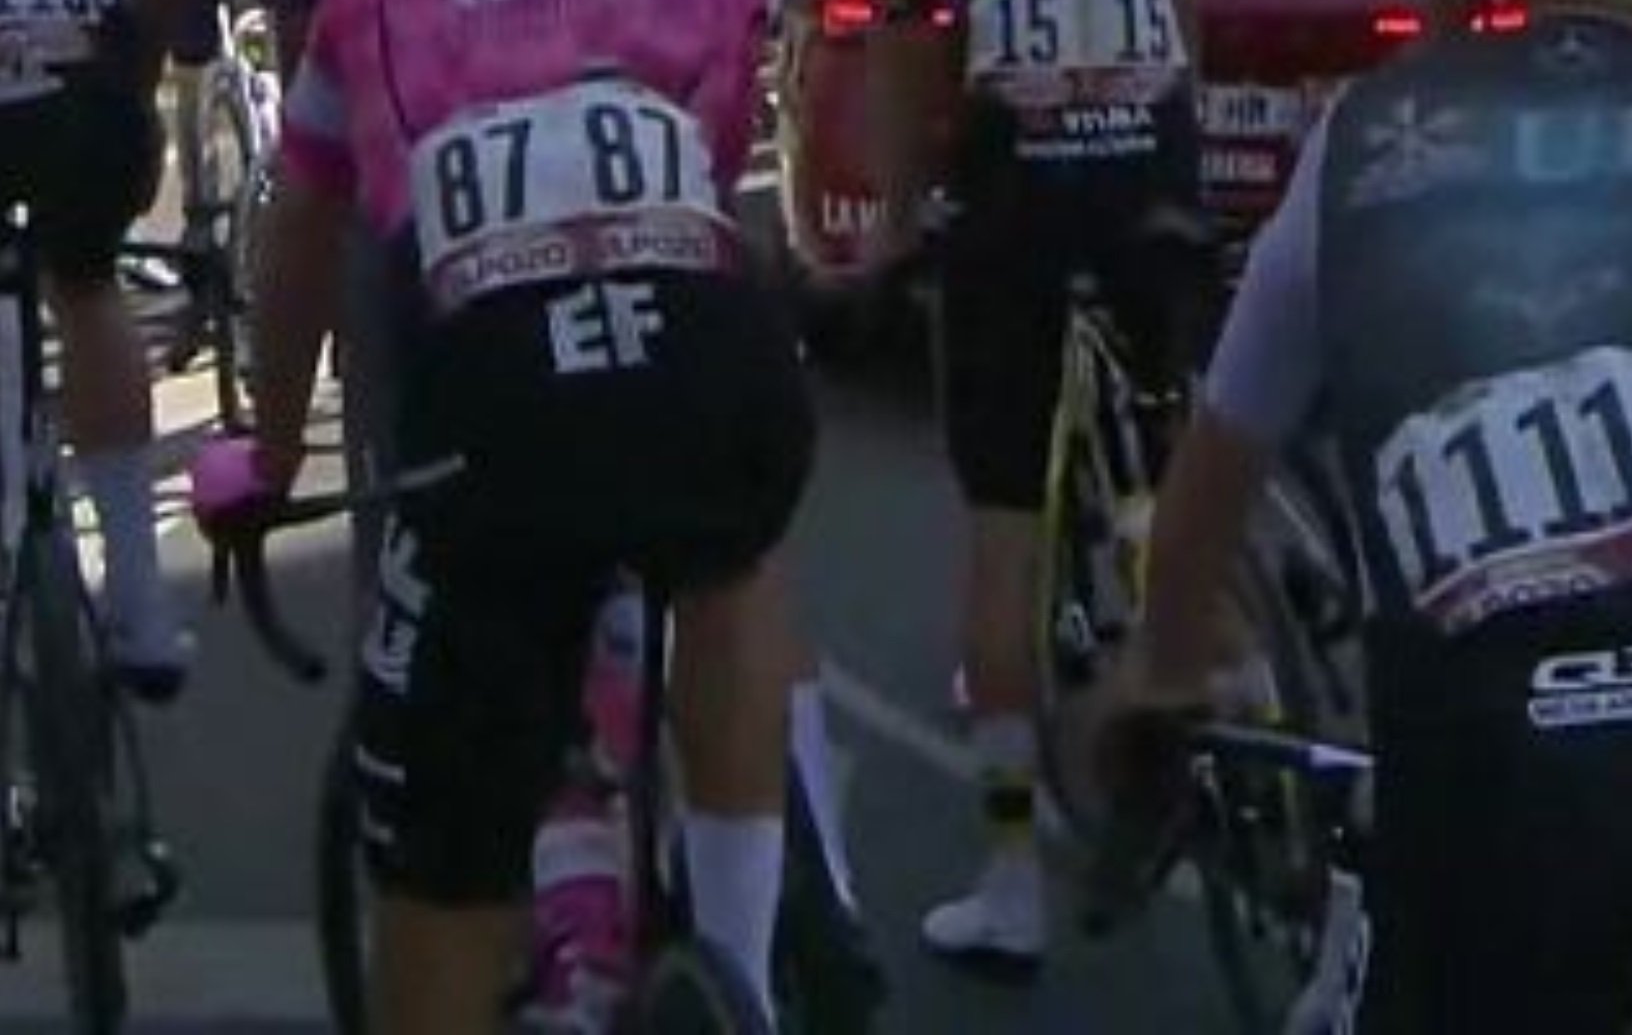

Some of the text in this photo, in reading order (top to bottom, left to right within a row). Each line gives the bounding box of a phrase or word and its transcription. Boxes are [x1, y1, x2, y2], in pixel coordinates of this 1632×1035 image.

[437, 102, 682, 238] 87 87
[544, 282, 666, 374] EF
